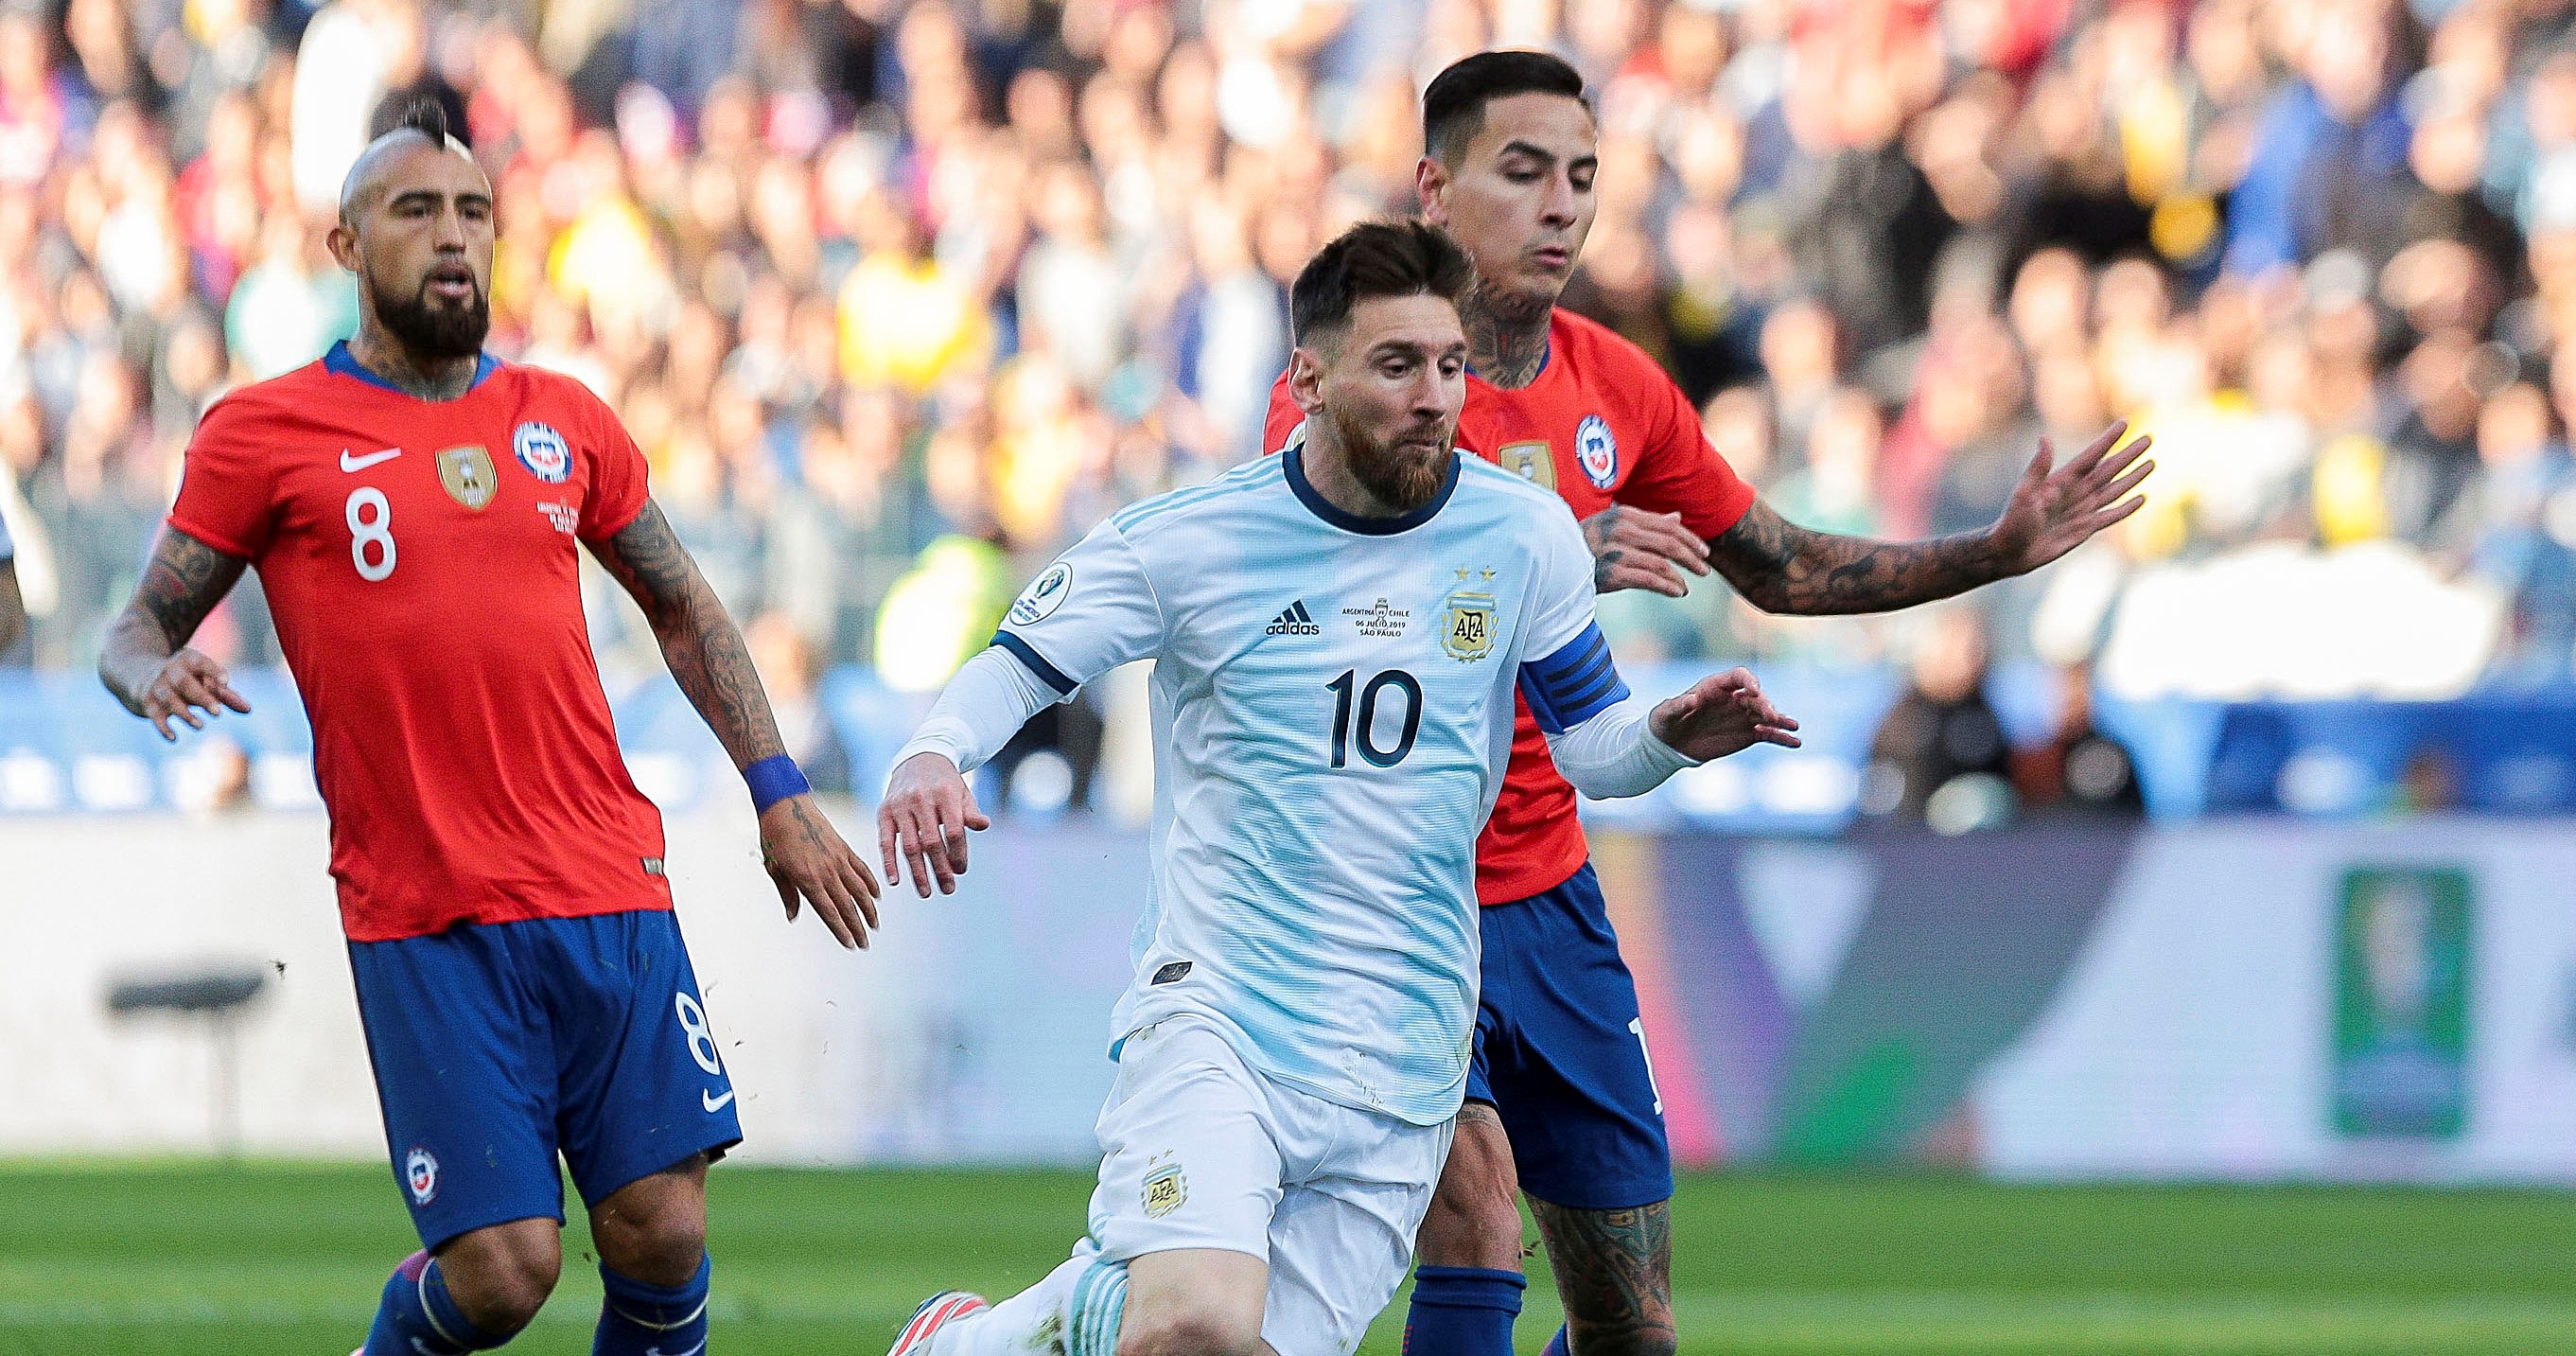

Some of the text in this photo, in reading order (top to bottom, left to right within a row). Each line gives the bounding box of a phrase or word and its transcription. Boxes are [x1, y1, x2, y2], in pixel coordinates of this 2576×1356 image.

[345, 485, 396, 582] 8
[1266, 622, 1320, 635] adidas
[1454, 609, 1485, 643] AFA
[1324, 668, 1424, 769] 10
[675, 991, 721, 1076] 8
